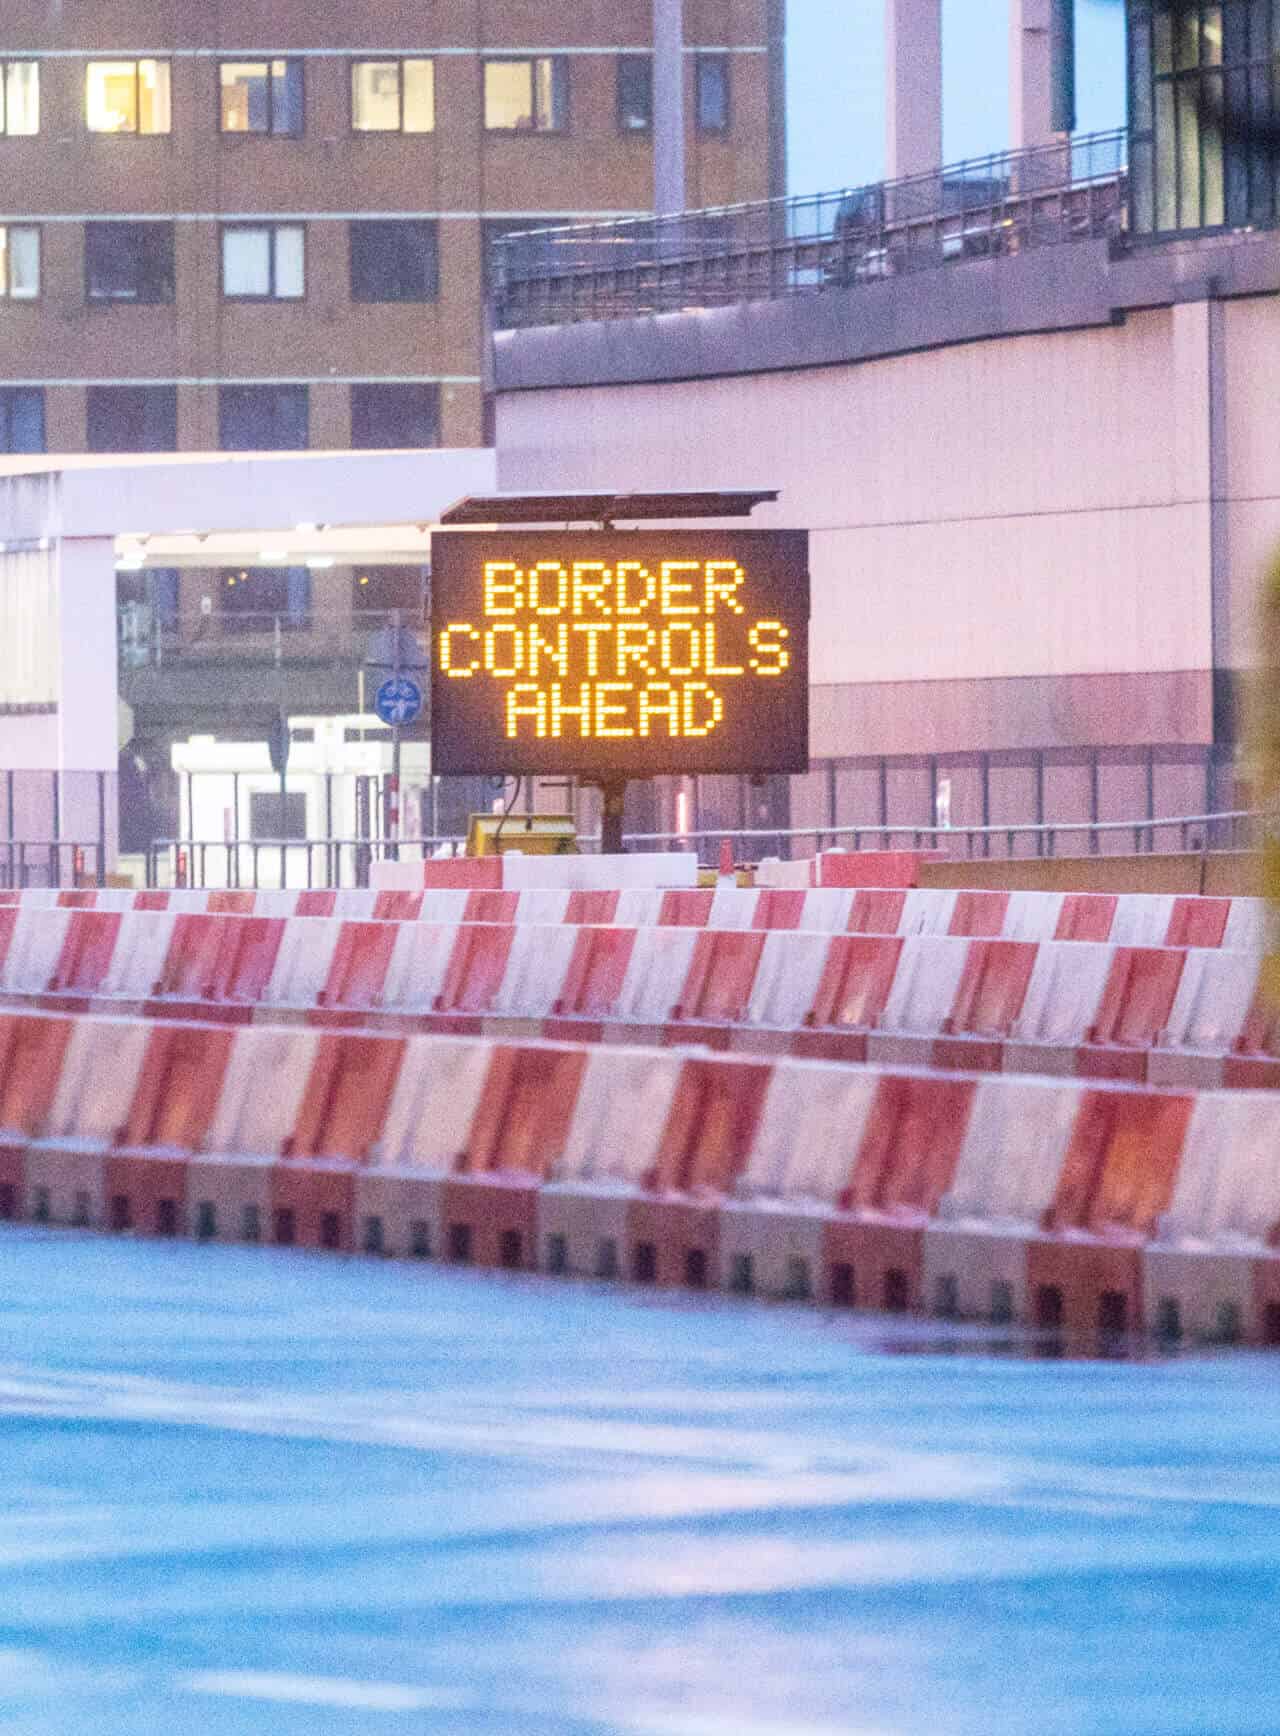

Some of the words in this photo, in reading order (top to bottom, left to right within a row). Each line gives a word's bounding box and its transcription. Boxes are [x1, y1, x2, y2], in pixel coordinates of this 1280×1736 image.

[484, 560, 745, 616] BORDER
[439, 621, 790, 677] CONTROLS
[506, 682, 723, 738] AHEAD
